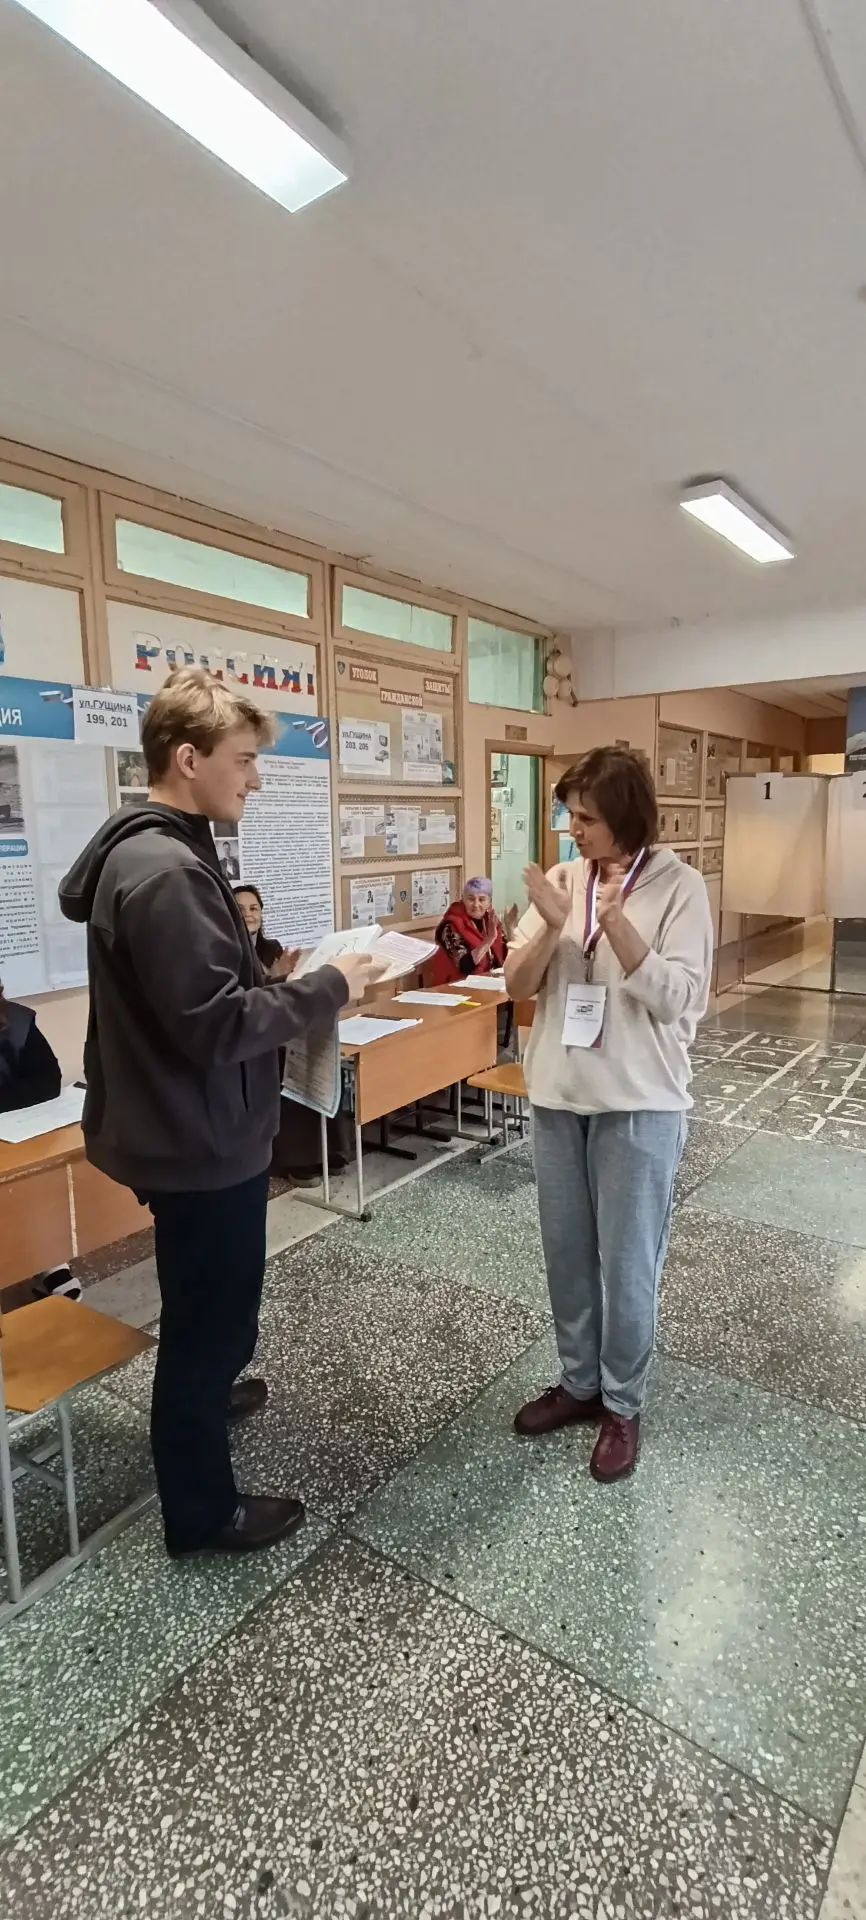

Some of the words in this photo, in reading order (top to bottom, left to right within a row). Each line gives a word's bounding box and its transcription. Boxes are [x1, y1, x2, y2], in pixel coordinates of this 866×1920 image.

[133, 631, 315, 696] РОССИЯ!
[352, 667, 377, 681] УГОЛОК
[425, 680, 450, 694] ЗАЩИТЫ
[380, 690, 423, 707] ГРАЖДАНСКОЙ
[79, 699, 133, 713] ул.ГУЩИНА
[86, 713, 108, 727] 199,
[111, 716, 128, 727] 201
[762, 781, 772, 800] 1
